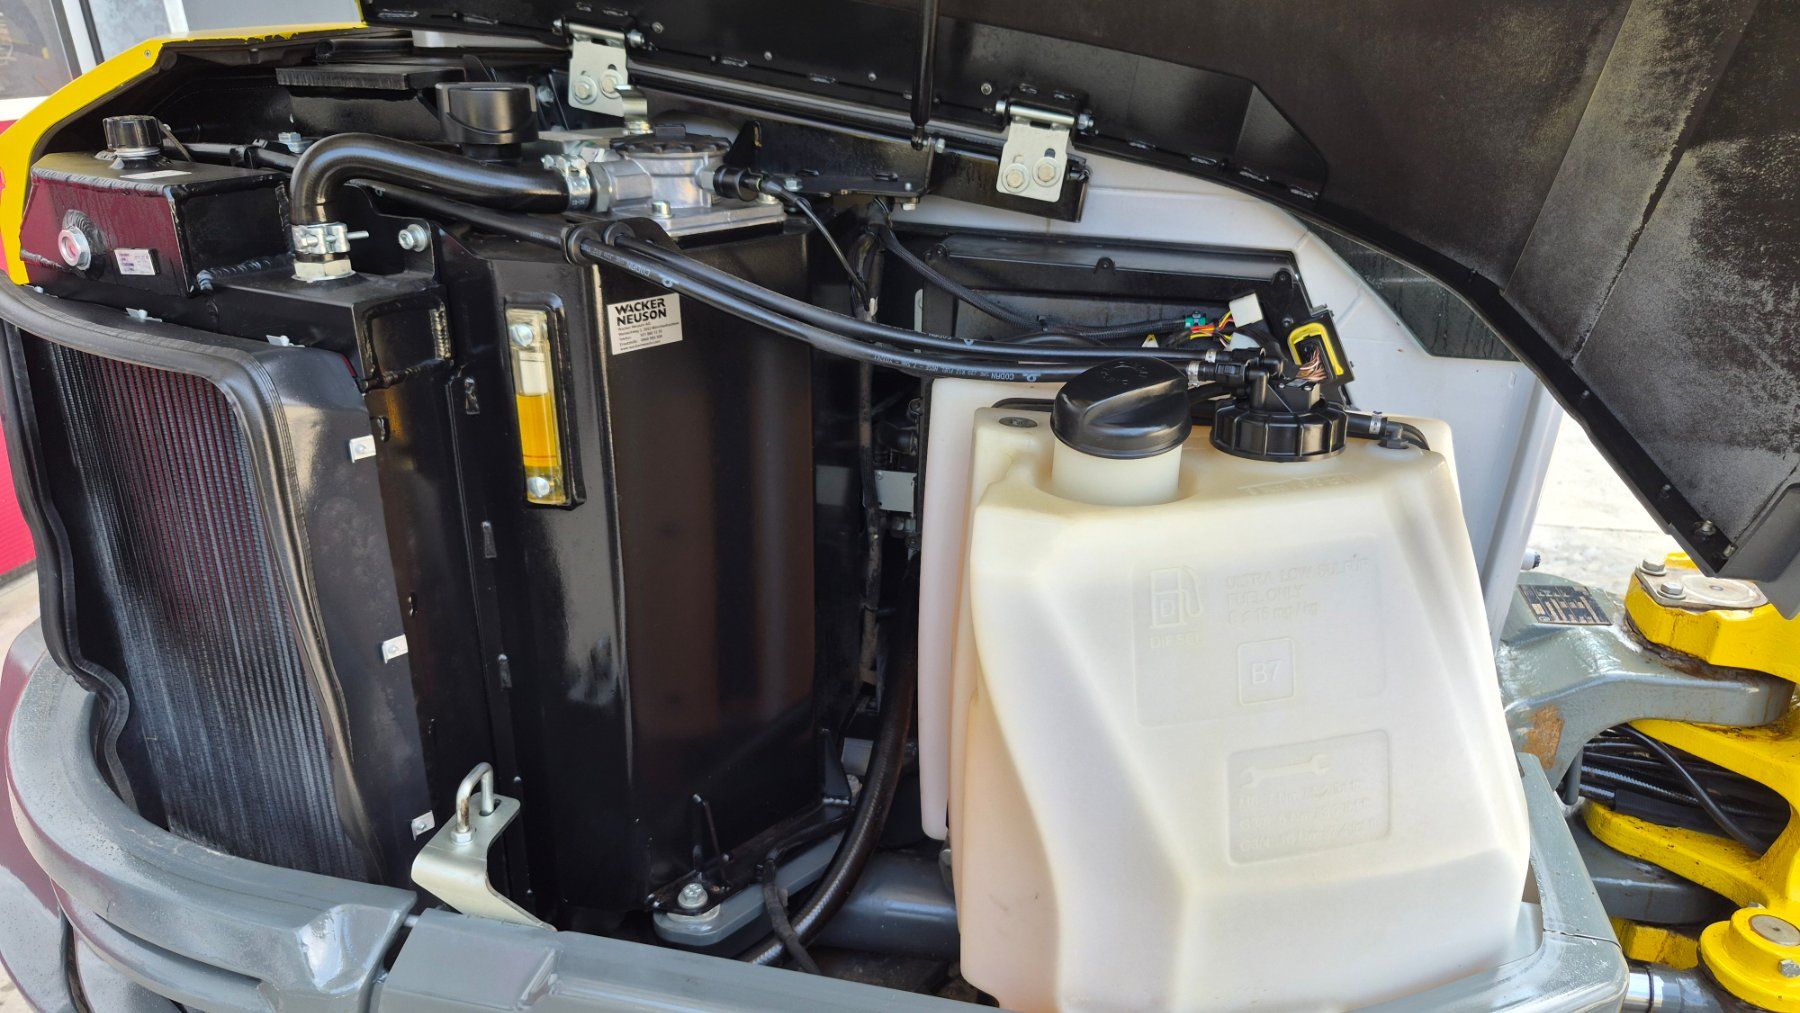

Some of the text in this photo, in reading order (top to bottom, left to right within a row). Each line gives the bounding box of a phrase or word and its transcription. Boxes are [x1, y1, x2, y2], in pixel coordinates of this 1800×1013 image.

[615, 298, 666, 315] WACKER
[617, 308, 667, 326] NEUSON
[991, 371, 1015, 381] CODAN
[1251, 660, 1286, 685] B7
